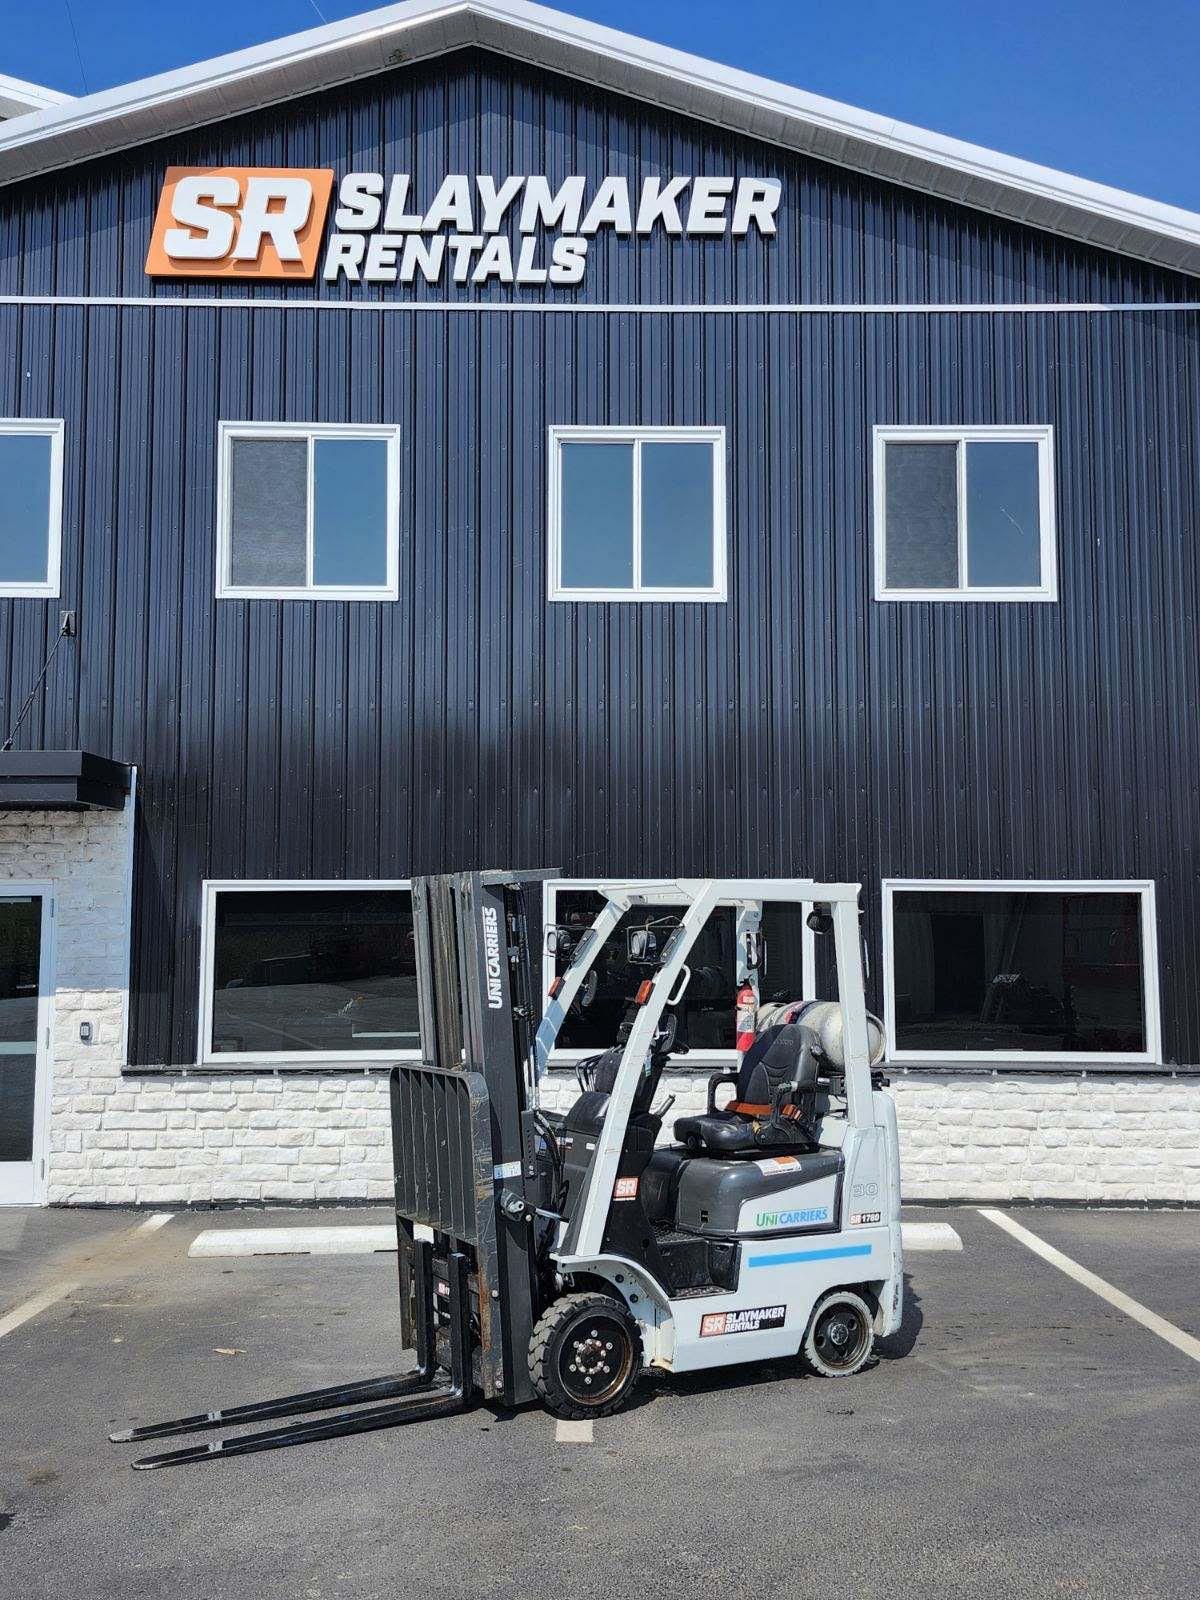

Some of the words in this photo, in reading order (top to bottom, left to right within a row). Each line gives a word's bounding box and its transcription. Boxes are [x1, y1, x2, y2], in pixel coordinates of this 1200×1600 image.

[335, 173, 783, 235] SLAYMAKER
[163, 176, 314, 261] SR
[322, 234, 588, 284] RENTALS
[617, 1180, 636, 1196] SR
[726, 1306, 784, 1323] SLAYMAKER
[704, 1316, 724, 1332] SR
[725, 1321, 760, 1333] RENTALS
